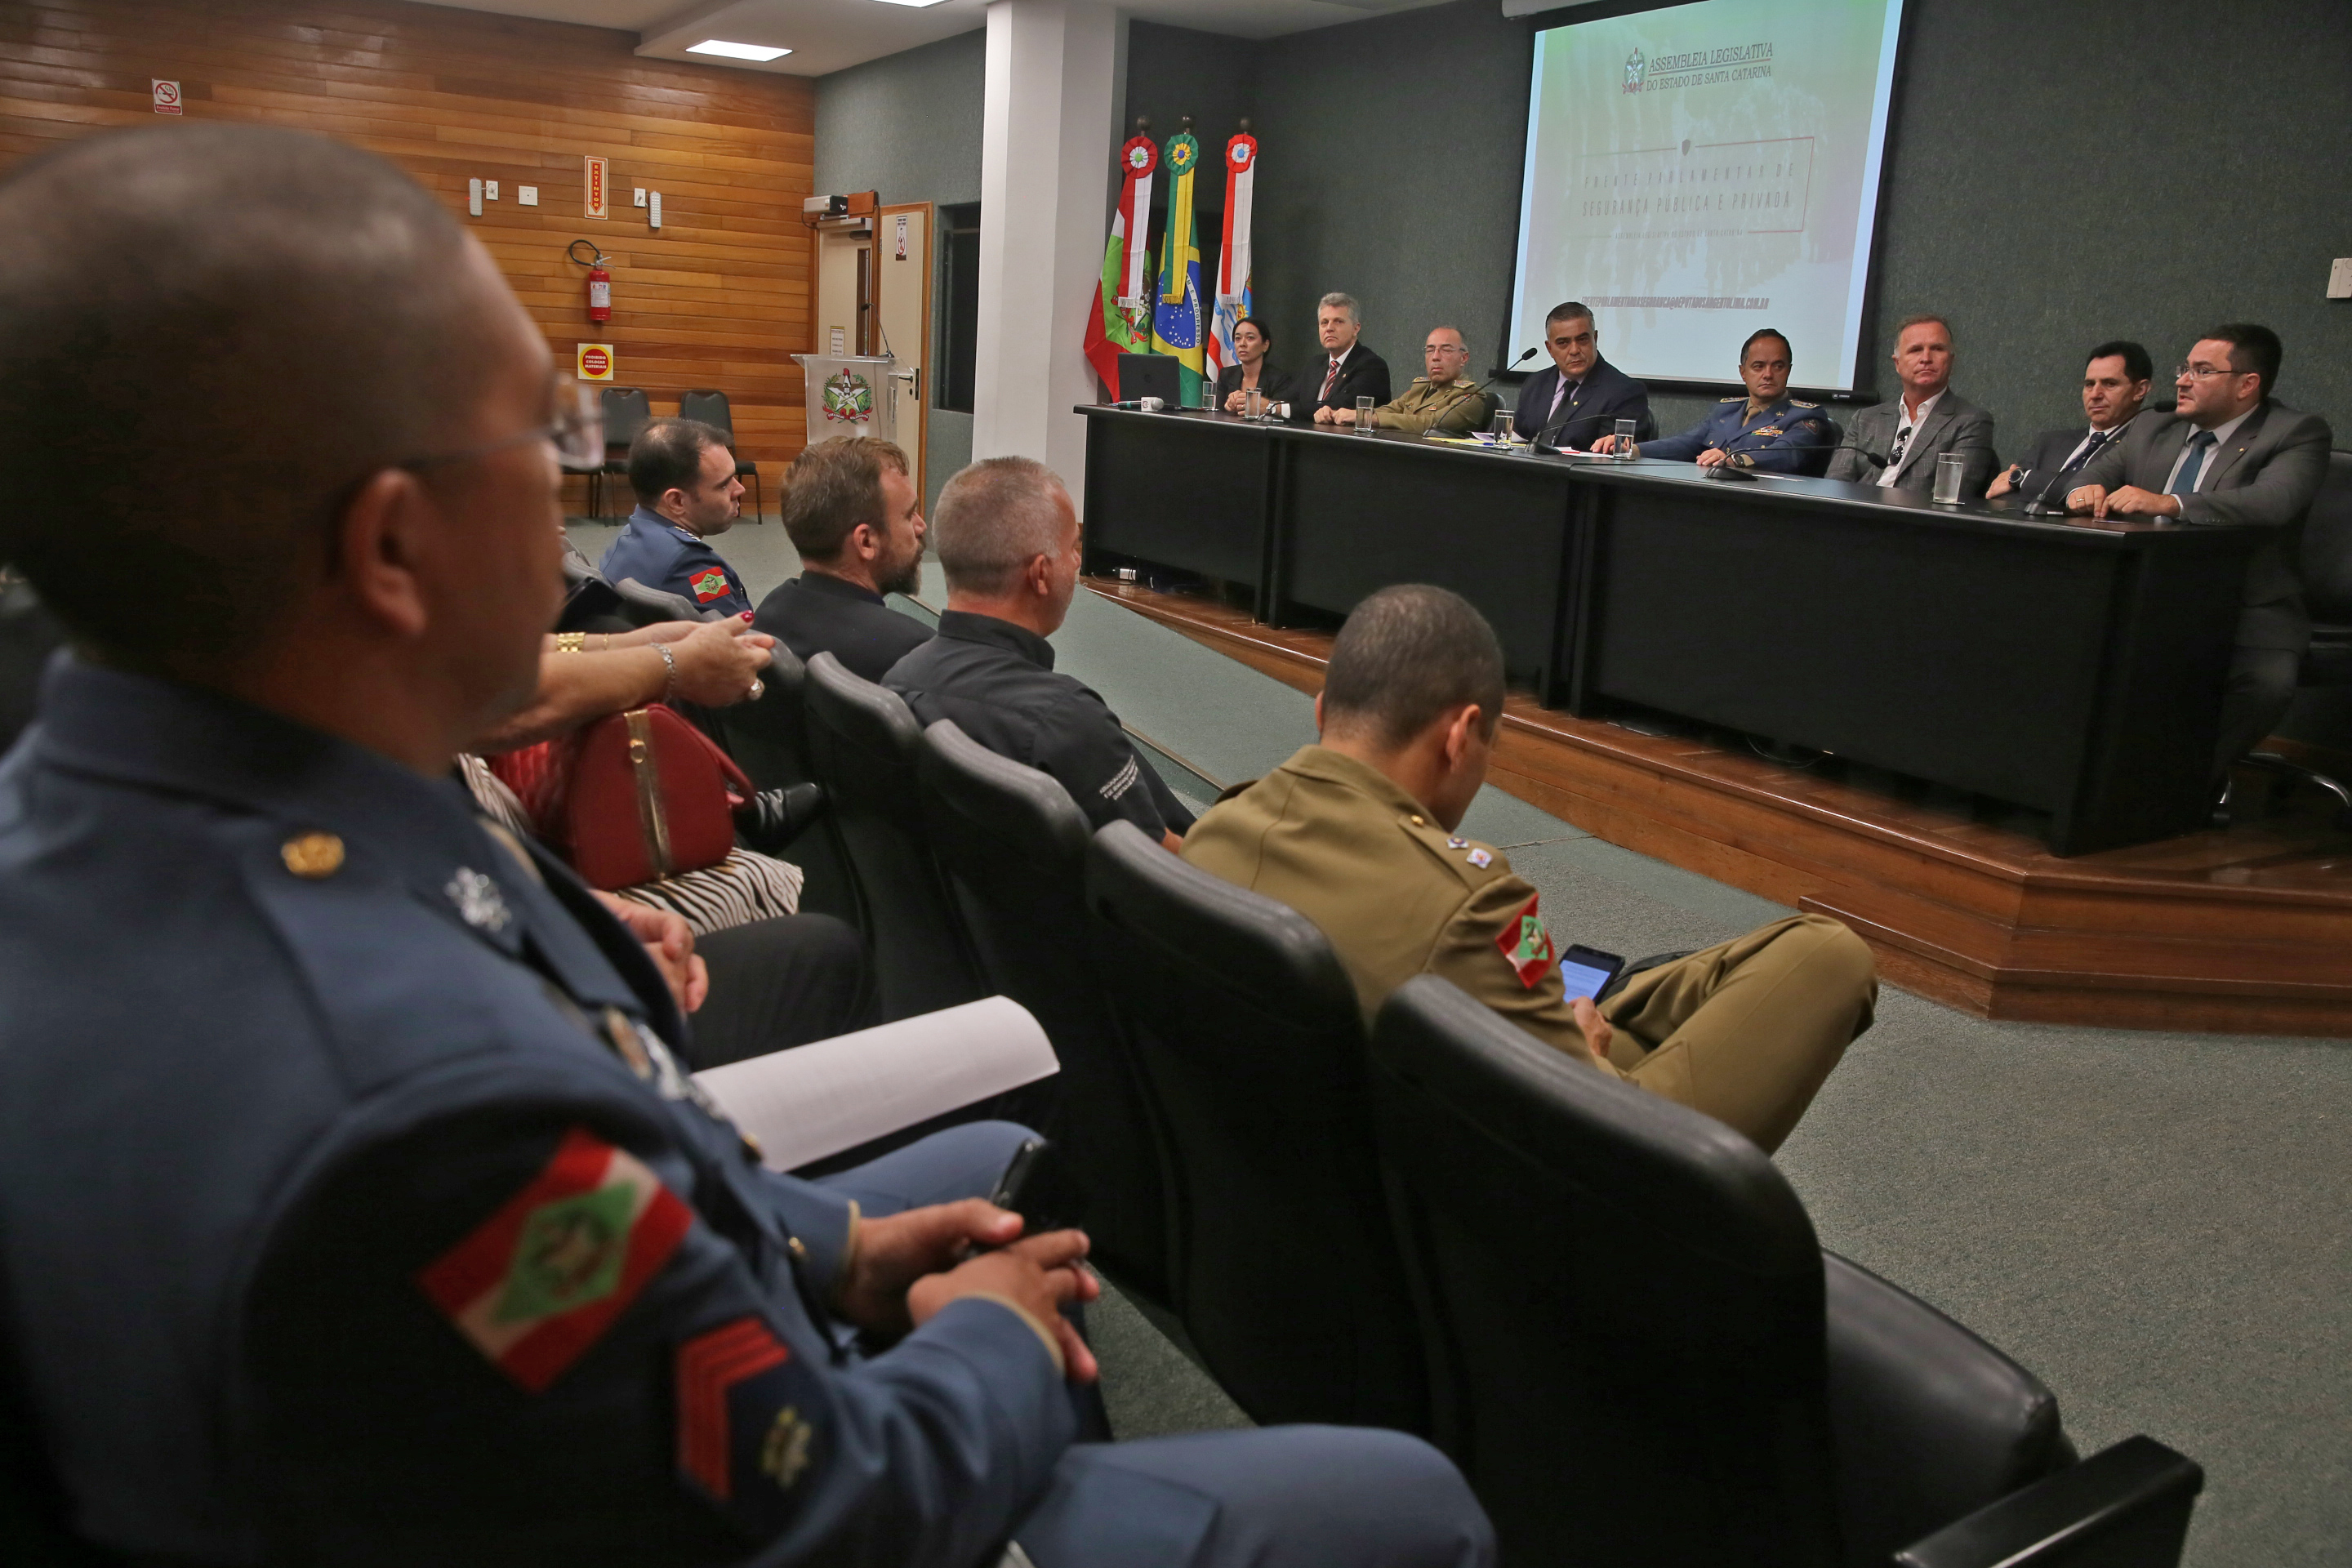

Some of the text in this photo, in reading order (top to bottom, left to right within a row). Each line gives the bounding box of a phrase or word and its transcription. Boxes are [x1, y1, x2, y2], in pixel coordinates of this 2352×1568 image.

[1648, 42, 1773, 72] ASSEMBLEIA LEGISLATIVA
[1646, 65, 1771, 91] DO ESTADO DE SANTA CATARINA
[1584, 163, 1793, 189] FRENTE PARLAMENTAR DE
[1583, 190, 1789, 217] SEGURANÇA PÚBLICA E PRIVADA
